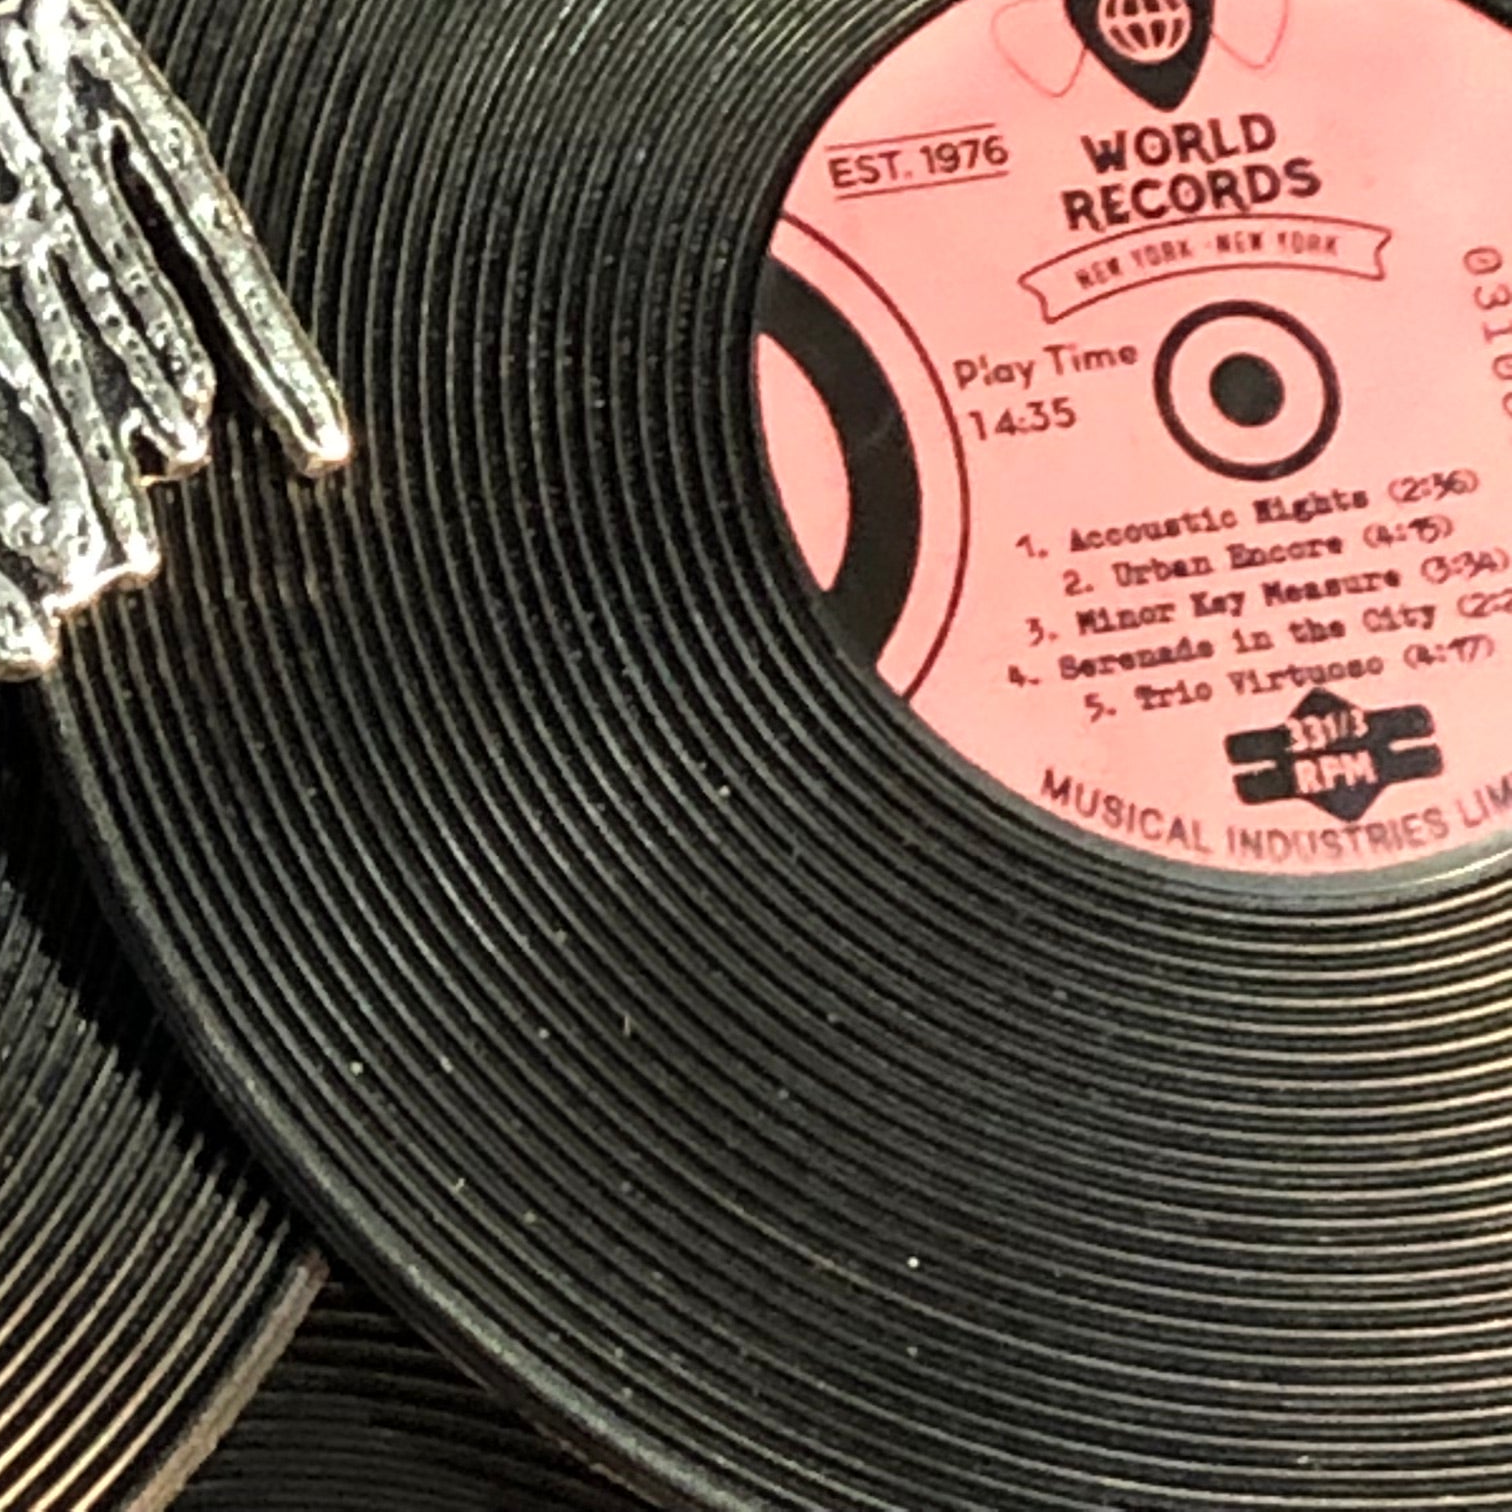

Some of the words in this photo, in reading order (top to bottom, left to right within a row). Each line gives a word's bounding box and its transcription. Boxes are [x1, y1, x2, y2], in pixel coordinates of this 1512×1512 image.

[828, 150, 912, 188] EST.
[920, 135, 1009, 175] 1976
[1080, 112, 1276, 174] WORLD
[1061, 157, 1322, 232] RECORDS
[953, 354, 1036, 391] Play
[1043, 343, 1138, 377] Time
[969, 397, 1077, 442] 14:35
[1016, 533, 1048, 558] 1.
[1070, 506, 1239, 552] Accoustic
[1062, 569, 1094, 596] 2.
[1112, 555, 1214, 588] Urban
[1226, 536, 1343, 570] Encore
[1026, 616, 1058, 647] 3.
[1076, 602, 1176, 636] Minor
[1190, 590, 1245, 617] Key
[1262, 569, 1401, 607] Measure
[1008, 664, 1041, 688] 4.
[1058, 636, 1215, 680] Serenade
[1232, 628, 1275, 654] in
[1288, 618, 1345, 644] the
[1363, 604, 1436, 633] City
[1084, 692, 1117, 723] 5.
[1134, 679, 1213, 711] Trio
[1227, 655, 1384, 695] Virtuoso
[1294, 750, 1378, 795] RPM
[1040, 766, 1214, 855] MUSICAL
[1226, 806, 1450, 862] INDUSTRIES
